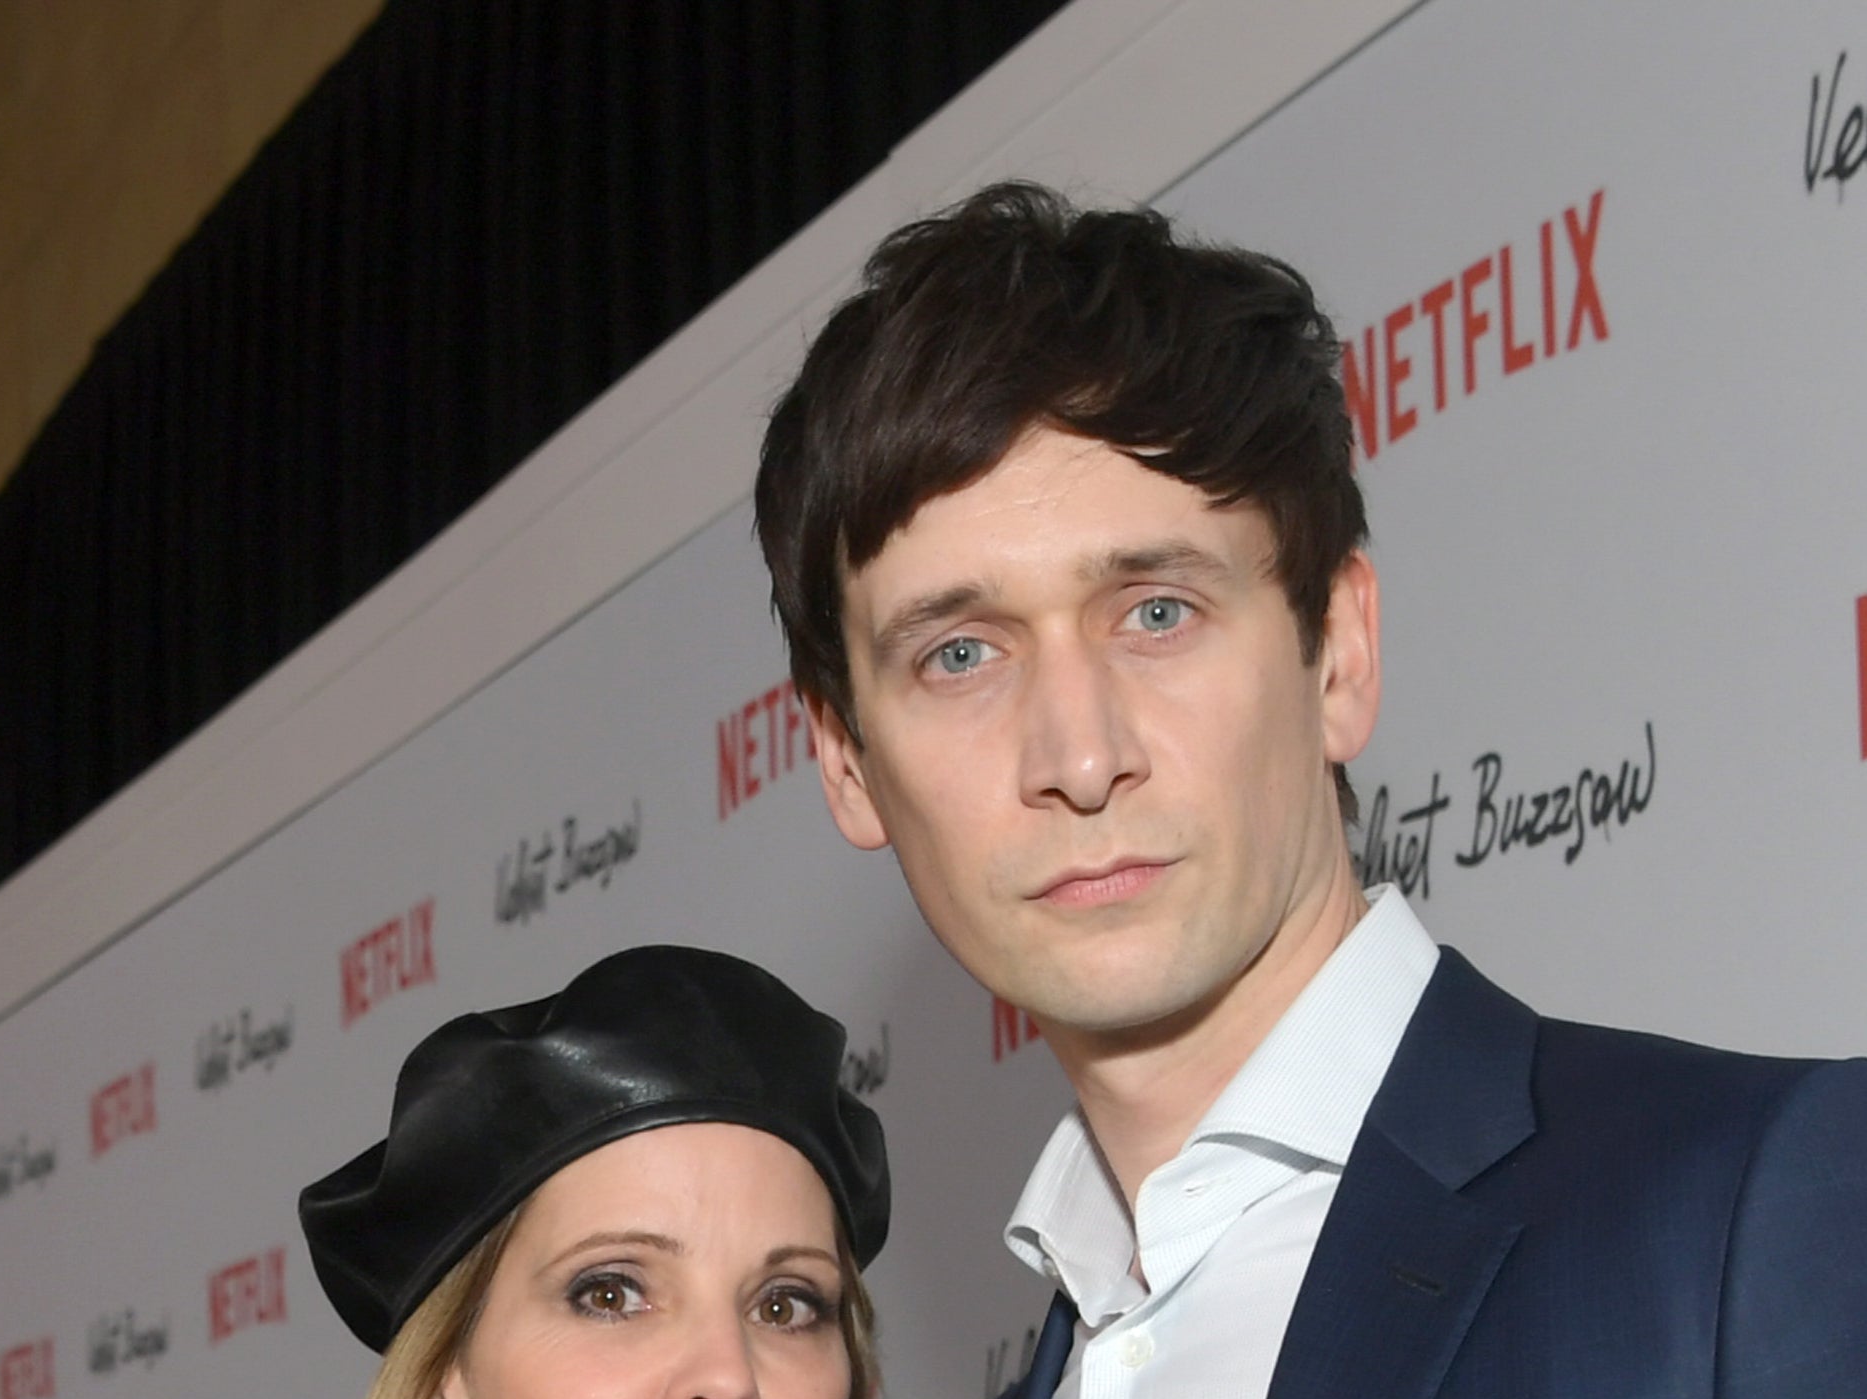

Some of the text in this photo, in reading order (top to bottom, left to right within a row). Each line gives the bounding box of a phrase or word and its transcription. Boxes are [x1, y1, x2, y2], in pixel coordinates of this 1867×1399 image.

[1342, 189, 1610, 470] NETFLIX
[716, 677, 818, 823] NETF
[1454, 721, 1657, 866] Buzzsaw
